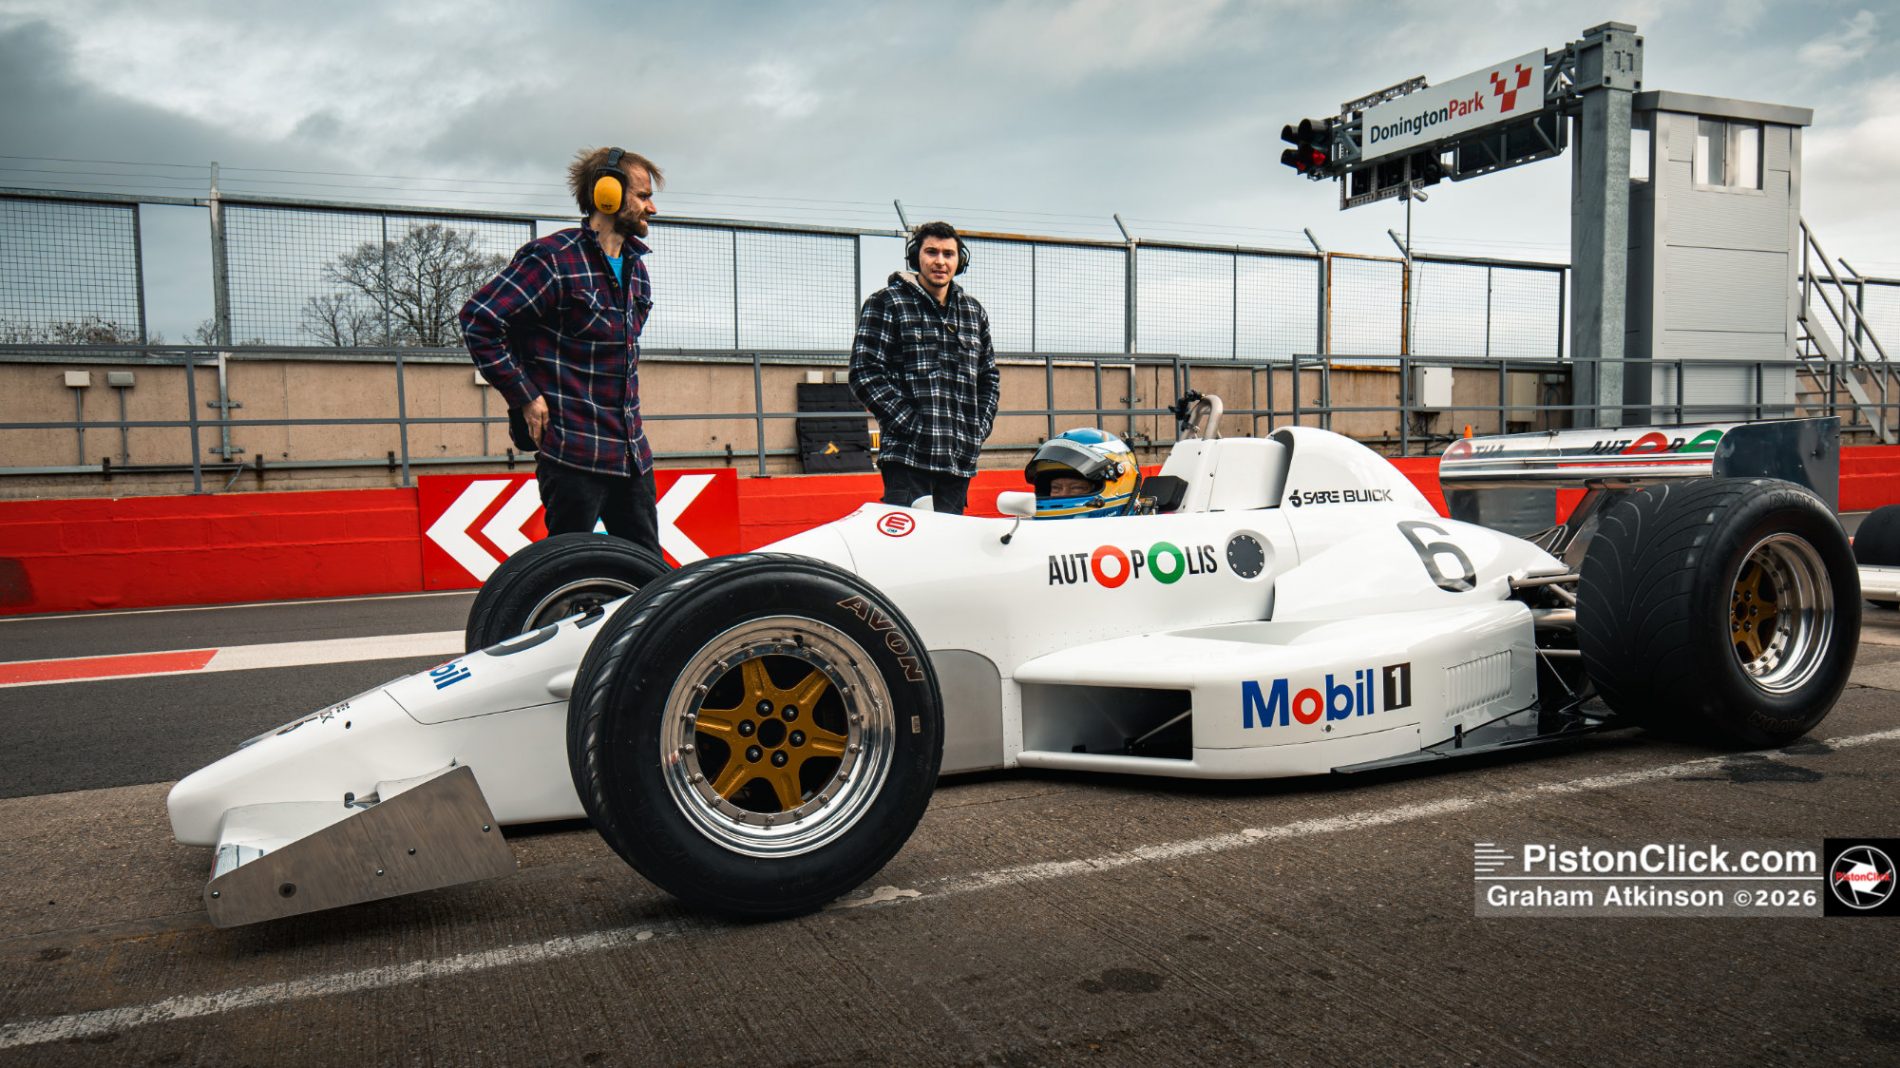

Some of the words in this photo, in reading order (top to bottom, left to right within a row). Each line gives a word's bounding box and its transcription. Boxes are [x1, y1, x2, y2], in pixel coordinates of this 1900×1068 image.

[1370, 91, 1484, 144] DoningtonPark
[1303, 489, 1340, 504] SABRE
[1343, 489, 1394, 504] BUICK
[1048, 541, 1218, 589] AUTOPOLIS
[1397, 520, 1477, 593] 6
[836, 594, 925, 682] AVON
[1241, 668, 1374, 729] Mobil
